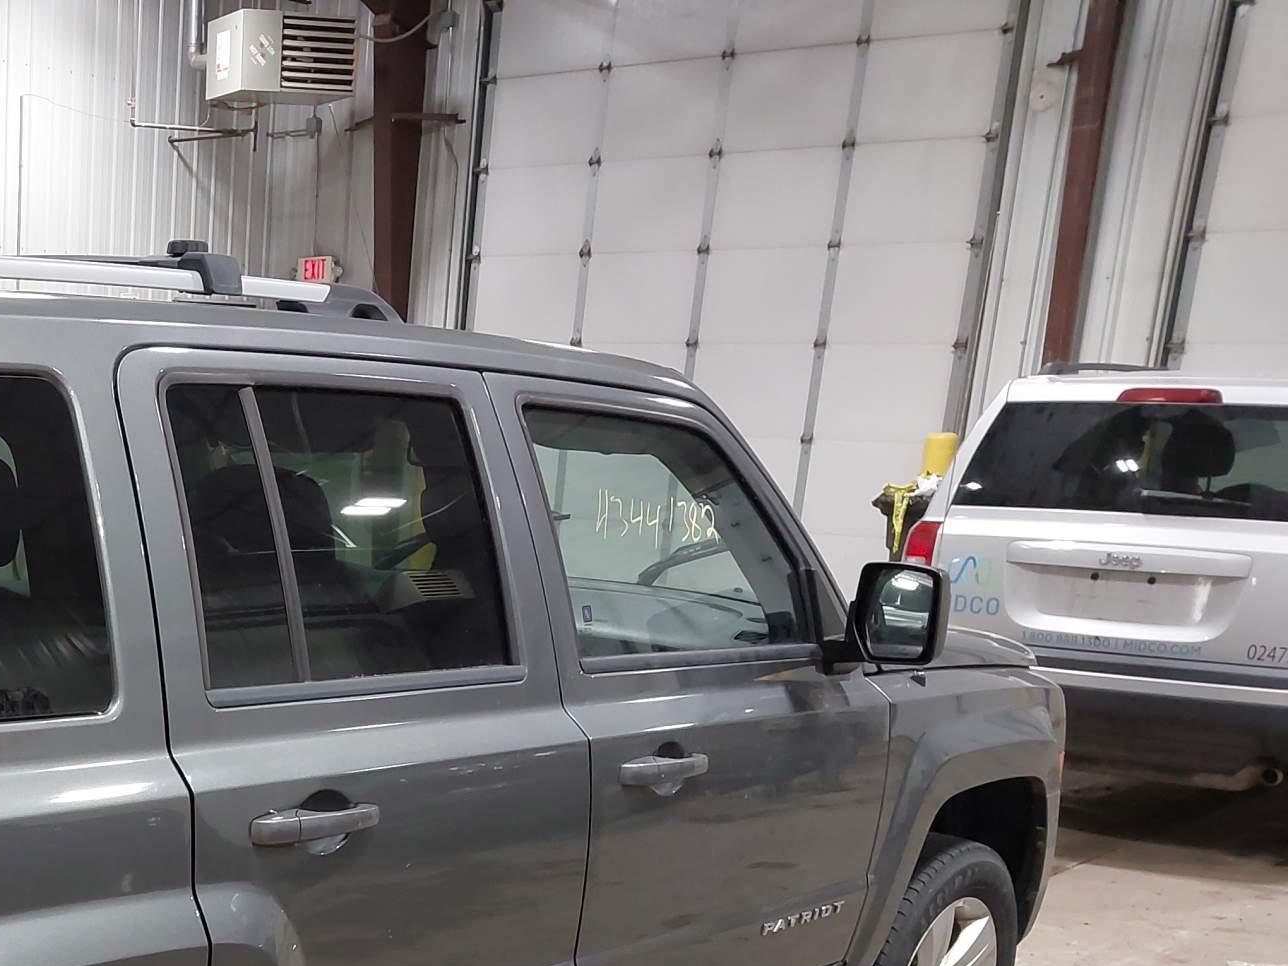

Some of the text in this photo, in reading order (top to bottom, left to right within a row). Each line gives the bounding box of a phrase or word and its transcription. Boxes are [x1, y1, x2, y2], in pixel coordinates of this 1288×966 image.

[304, 258, 326, 280] EXIT
[595, 487, 721, 549] 43441382
[1098, 552, 1143, 570] Jeep
[952, 594, 1000, 616] DCO
[1247, 643, 1288, 663] 0247
[761, 900, 846, 936] PATRIOT
